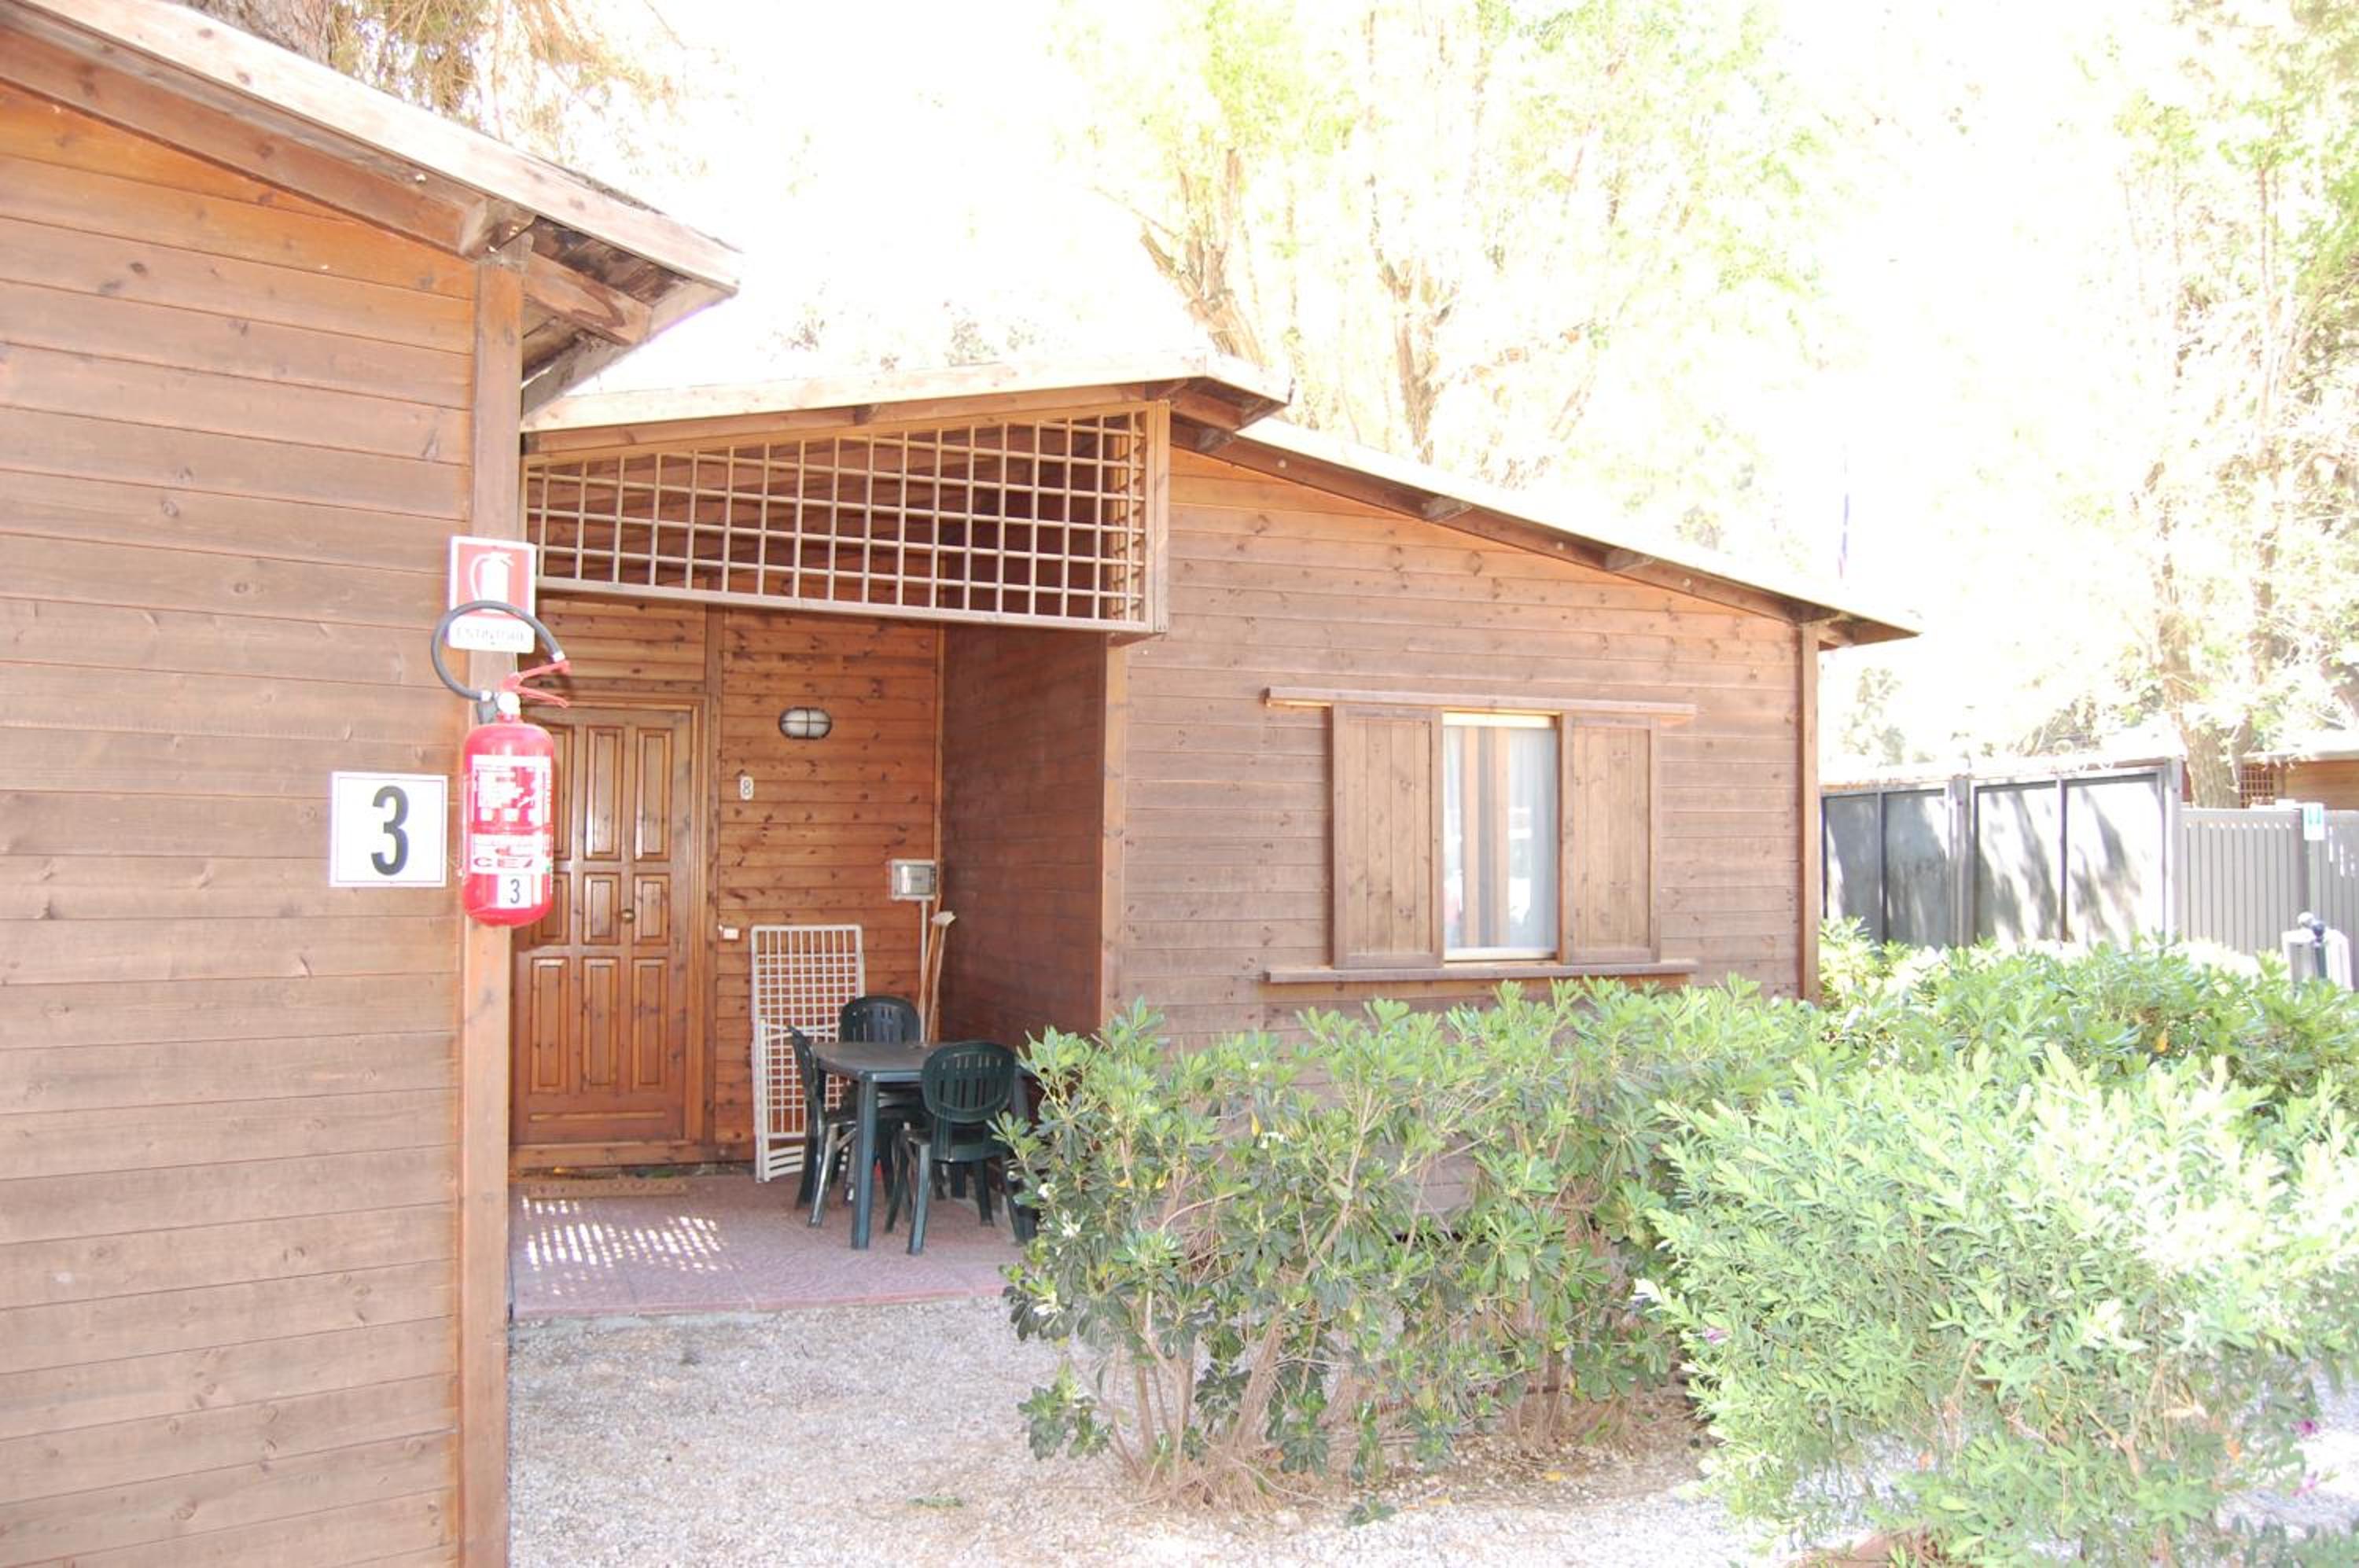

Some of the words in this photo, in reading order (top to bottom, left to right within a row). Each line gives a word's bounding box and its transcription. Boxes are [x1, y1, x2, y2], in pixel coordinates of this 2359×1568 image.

[742, 779, 751, 796] 8
[370, 785, 409, 876] 3
[510, 878, 521, 904] 3
